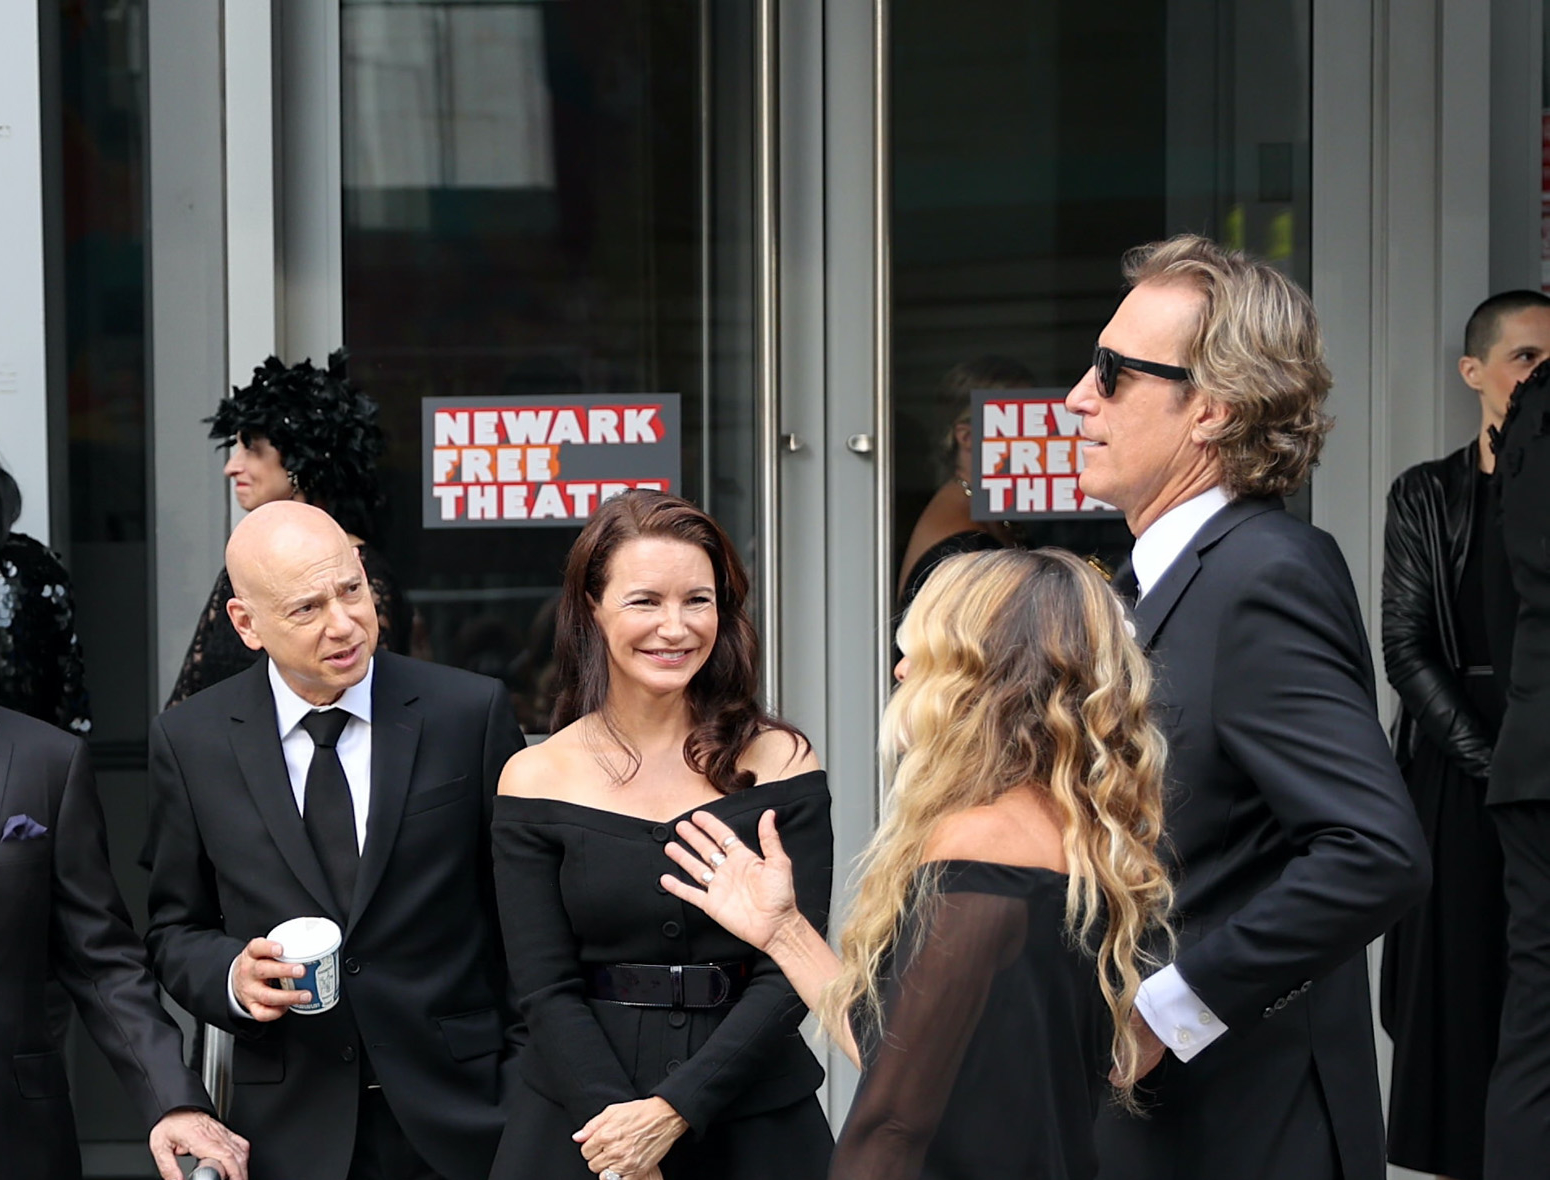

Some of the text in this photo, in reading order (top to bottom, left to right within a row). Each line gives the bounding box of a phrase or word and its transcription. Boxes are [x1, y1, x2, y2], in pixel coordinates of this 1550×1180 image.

[434, 408, 658, 446] NEWARK
[433, 447, 551, 483] FREE
[433, 483, 661, 520] THEAT
